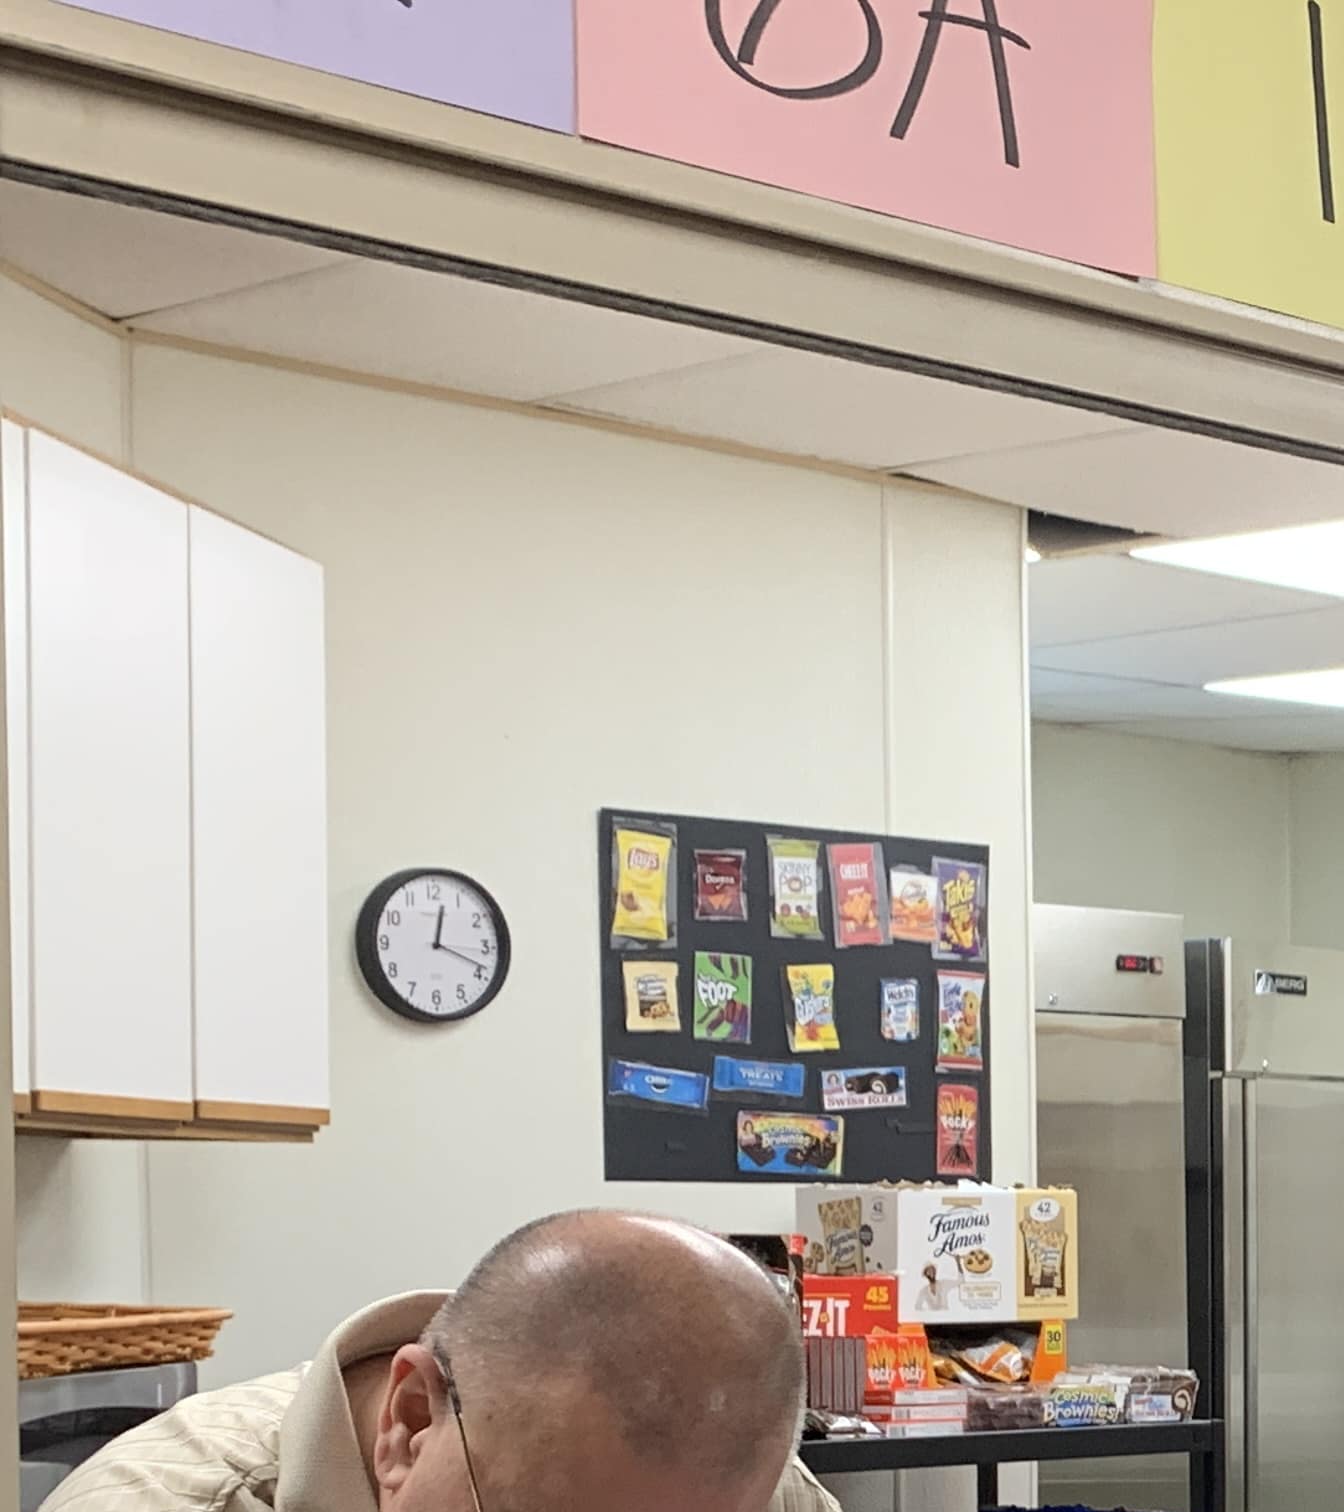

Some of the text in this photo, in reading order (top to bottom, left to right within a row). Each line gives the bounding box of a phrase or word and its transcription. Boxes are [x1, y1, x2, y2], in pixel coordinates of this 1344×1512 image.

[405, 890, 415, 907] 11
[426, 883, 441, 900] 12
[456, 893, 460, 908] 1
[386, 910, 401, 926] 10
[472, 913, 481, 928] 2
[379, 934, 389, 951] 9
[480, 939, 490, 955] 3
[388, 962, 398, 978] 8
[407, 981, 417, 997] 7
[431, 989, 442, 1005] 6
[456, 984, 465, 1000] 5
[1036, 1202, 1051, 1215] 42
[928, 1212, 991, 1242] Famous
[933, 1232, 984, 1258] Amos
[865, 1286, 889, 1303] 45
[1046, 1330, 1062, 1343] 30
